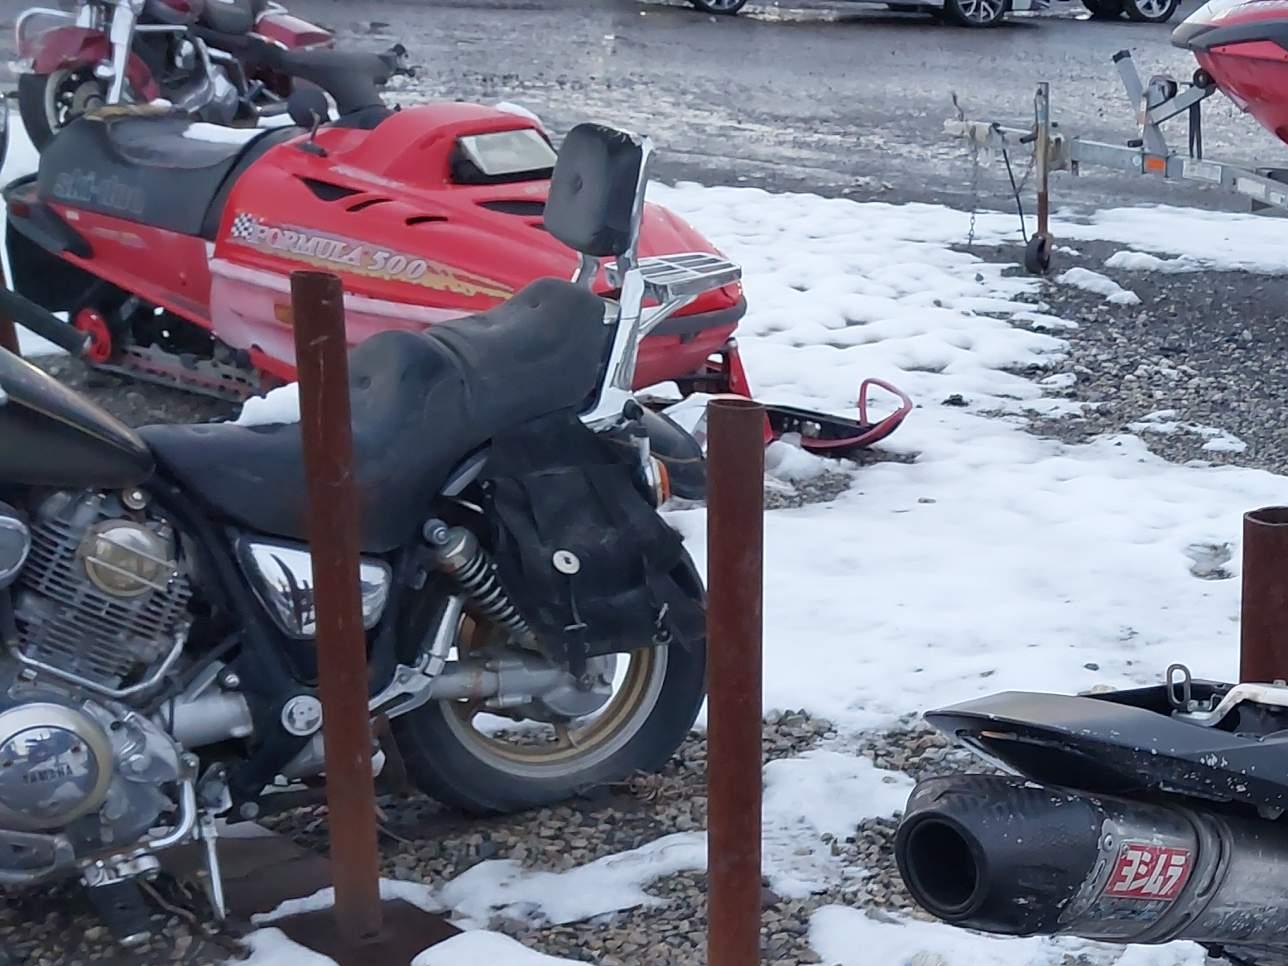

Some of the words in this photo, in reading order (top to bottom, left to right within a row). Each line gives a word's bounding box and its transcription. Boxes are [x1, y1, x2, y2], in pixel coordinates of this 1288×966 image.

[249, 223, 361, 266] FORMULA
[367, 250, 428, 279] 500
[1112, 850, 1186, 896] ヨシムラ
